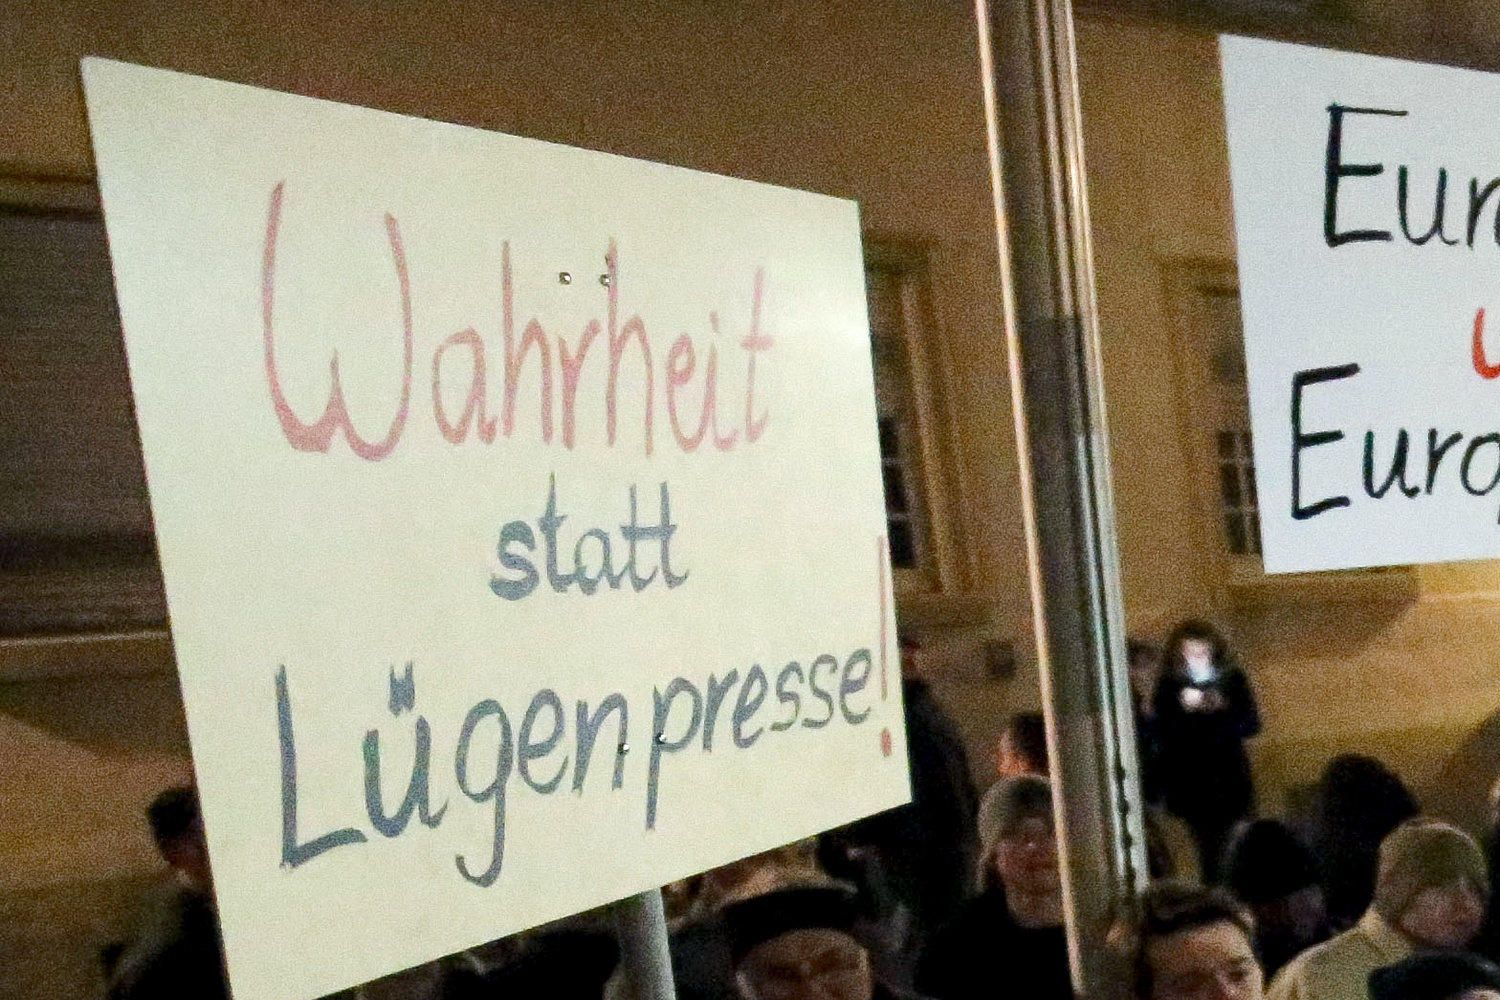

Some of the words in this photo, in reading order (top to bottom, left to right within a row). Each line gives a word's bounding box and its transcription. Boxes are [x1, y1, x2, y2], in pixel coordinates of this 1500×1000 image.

[263, 180, 778, 462] Wahrheit
[490, 472, 690, 600] statt
[274, 533, 894, 888] Lügenpresse!
